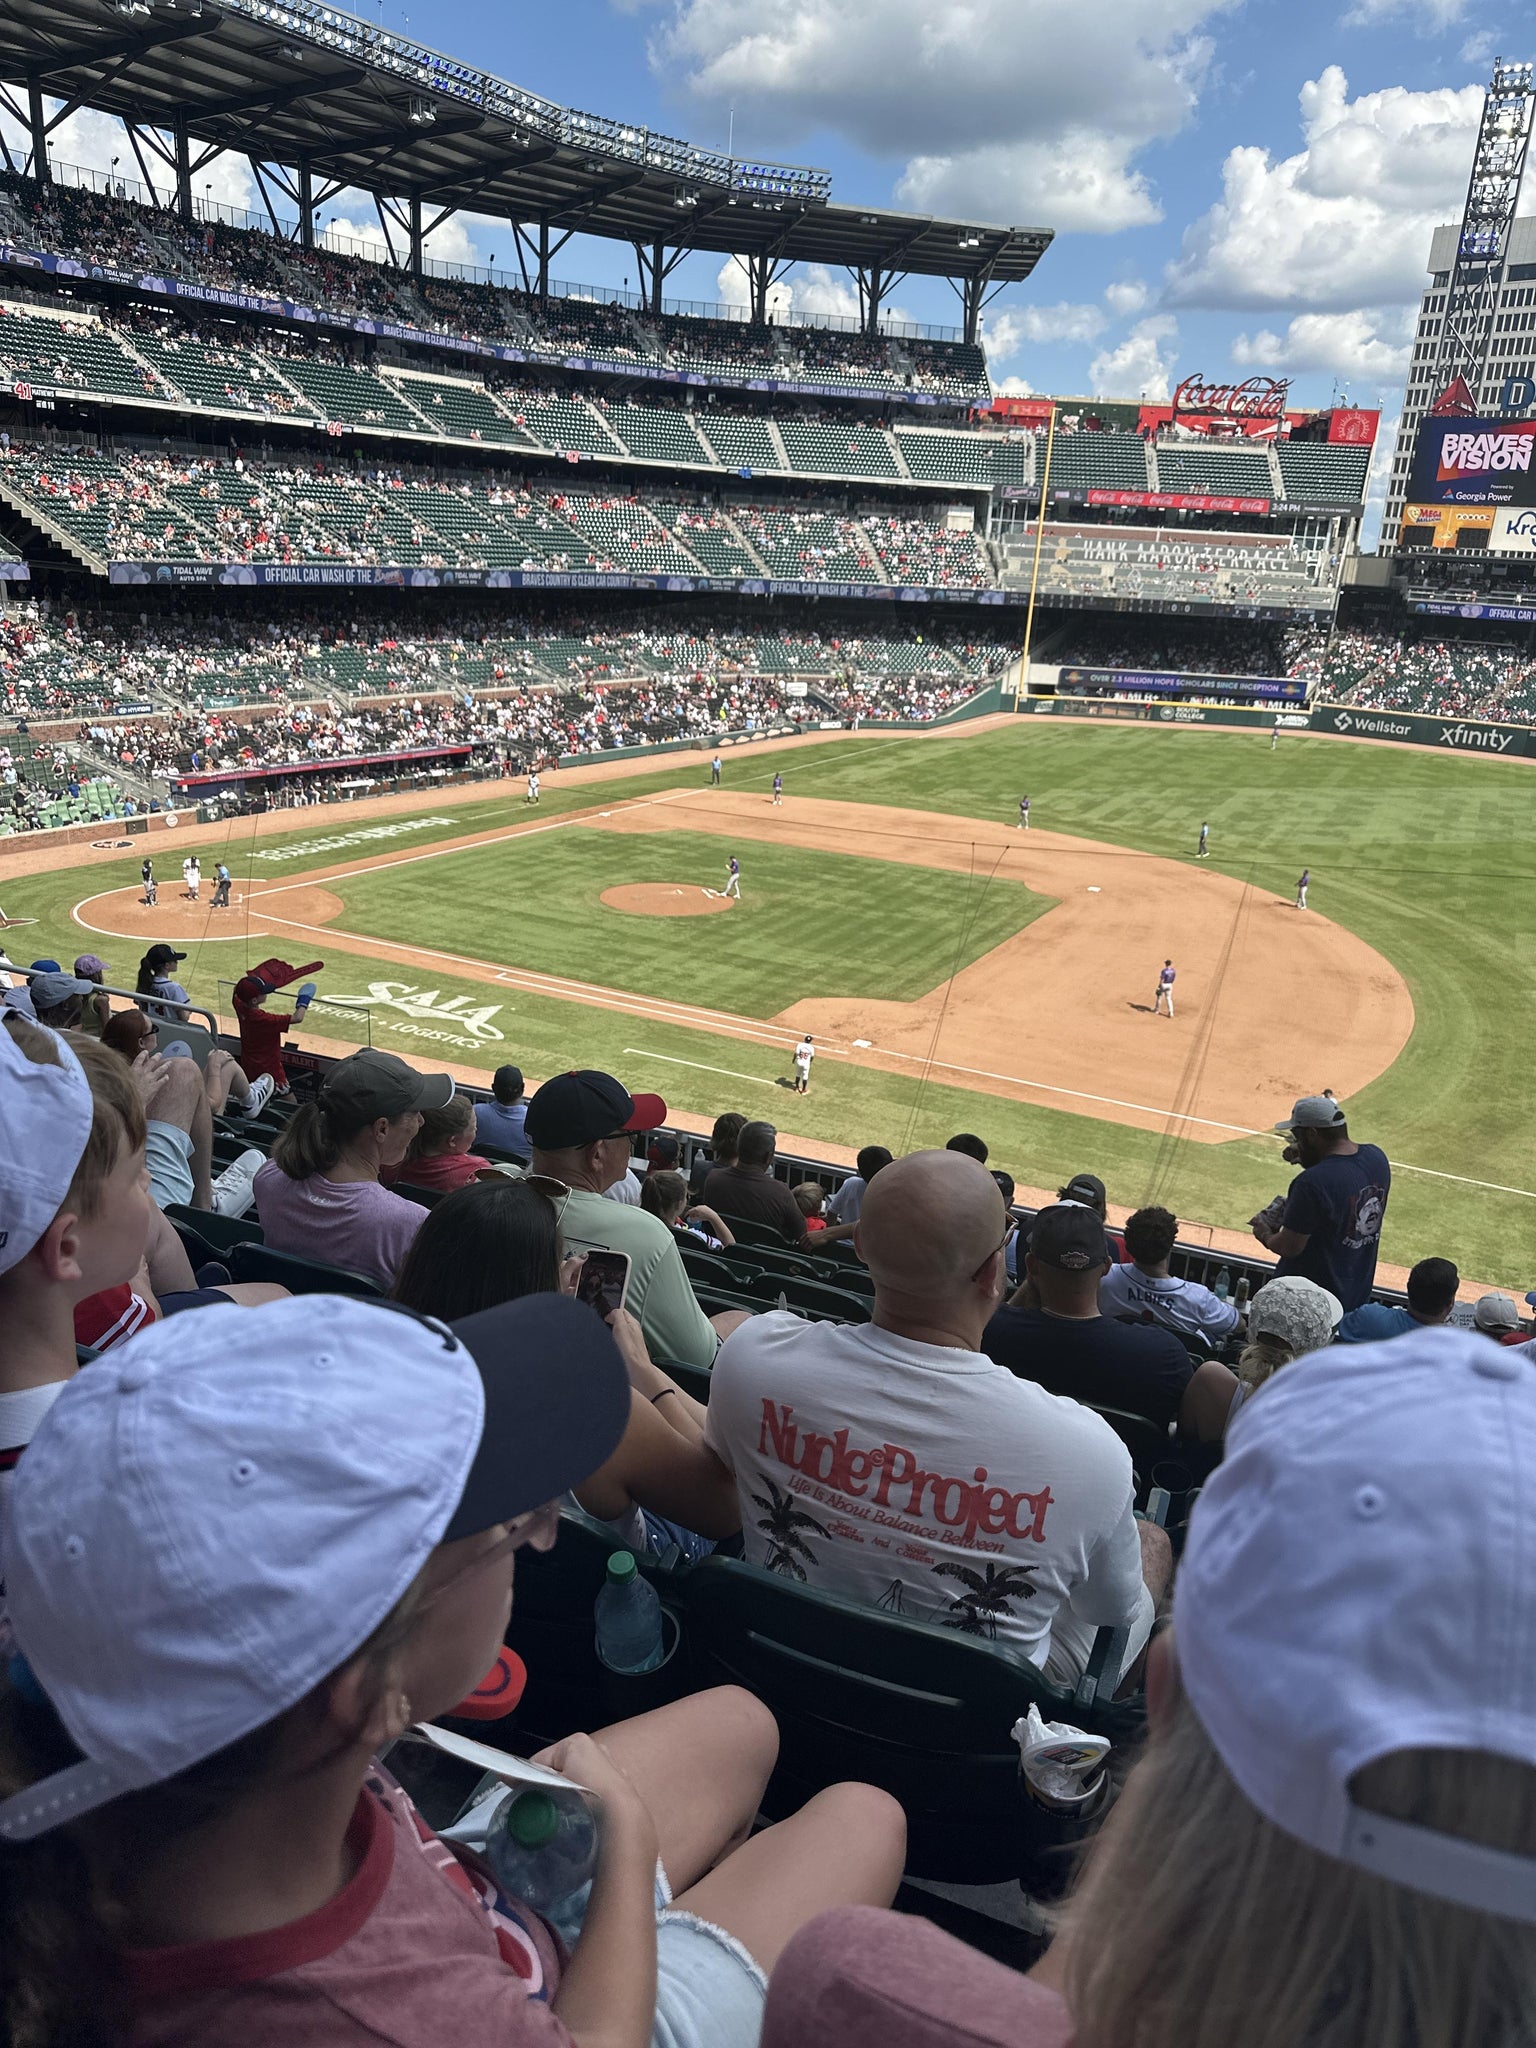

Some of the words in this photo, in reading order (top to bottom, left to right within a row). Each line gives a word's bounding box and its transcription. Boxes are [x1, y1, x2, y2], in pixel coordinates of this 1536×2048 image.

[104, 269, 118, 278] TIDAL
[118, 271, 134, 281] WAVE
[176, 282, 205, 299] OFFICIAL
[206, 289, 219, 302] CAR
[220, 292, 238, 306] WASH
[239, 295, 247, 307] OF
[248, 298, 259, 310] THE
[383, 324, 402, 338] BRAVES
[403, 327, 425, 341] COUNTRY
[426, 330, 431, 342] IS
[431, 331, 446, 345] CLEAN
[446, 334, 457, 346] CAR
[456, 336, 479, 351] COUNTRY
[592, 362, 614, 373] OFFICIAL
[614, 364, 626, 374] CAR
[626, 364, 641, 376] WASH
[642, 366, 648, 377] OF
[648, 367, 659, 378] THE
[14, 382, 32, 400] 41
[32, 388, 55, 397] MATHEWS
[778, 382, 799, 393] BRAVES
[799, 384, 824, 395] COUNTRY
[830, 386, 848, 397] CLEAN
[327, 420, 342, 436] 44
[1443, 434, 1535, 452] BRAVES
[1441, 450, 1532, 471] VISION
[1456, 492, 1486, 502] Georgia
[1487, 494, 1513, 502] Power
[1272, 503, 1288, 512] 3:24
[1288, 504, 1301, 512] PM
[1420, 508, 1442, 518] MEGA
[1084, 540, 1129, 562] HANK
[1138, 544, 1194, 566] AARON
[1204, 547, 1290, 572] TERRACE
[174, 566, 192, 575] TIDAL
[192, 567, 213, 576] WAVE
[265, 568, 302, 584] OFFICIAL
[303, 568, 321, 584] CAR
[322, 568, 344, 584] WASH
[346, 569, 356, 584] OF
[357, 569, 372, 584] THE
[454, 572, 468, 580] TIDAL
[468, 572, 482, 580] WAVE
[522, 573, 546, 586] BRAVES
[546, 574, 571, 587] COUNTRY
[572, 574, 577, 587] IS
[578, 574, 595, 587] CLEAN
[596, 574, 606, 587] CAR
[606, 574, 631, 587] COUNTRY
[770, 582, 801, 595] OFFICIAL
[801, 582, 818, 595] CAR
[818, 583, 839, 596] WASH
[840, 584, 849, 597] OF
[850, 585, 864, 597] THE
[1489, 608, 1516, 620] OFFICIAL
[1518, 610, 1531, 621] CAR
[1090, 674, 1110, 683] OVER
[1124, 676, 1154, 684] MILLION
[1154, 678, 1174, 686] HOPE
[1176, 679, 1215, 689] SCHOLARS
[1216, 680, 1238, 690] SINCE
[1239, 682, 1280, 693] INCEPTION
[1174, 712, 1206, 720] COLLEGE
[1355, 717, 1412, 736] Wellstar
[1440, 724, 1513, 751] xfinity
[321, 981, 505, 1041] SAIA
[308, 1001, 378, 1023] REIGHT
[388, 1022, 488, 1049] LOGISTICS
[1128, 1288, 1175, 1312] ALBIES
[788, 1474, 811, 1496] Life
[812, 1486, 824, 1501] Is
[826, 1493, 872, 1520] About
[872, 1510, 938, 1540] Balance
[940, 1529, 1006, 1554] Between
[871, 1536, 891, 1549] And
